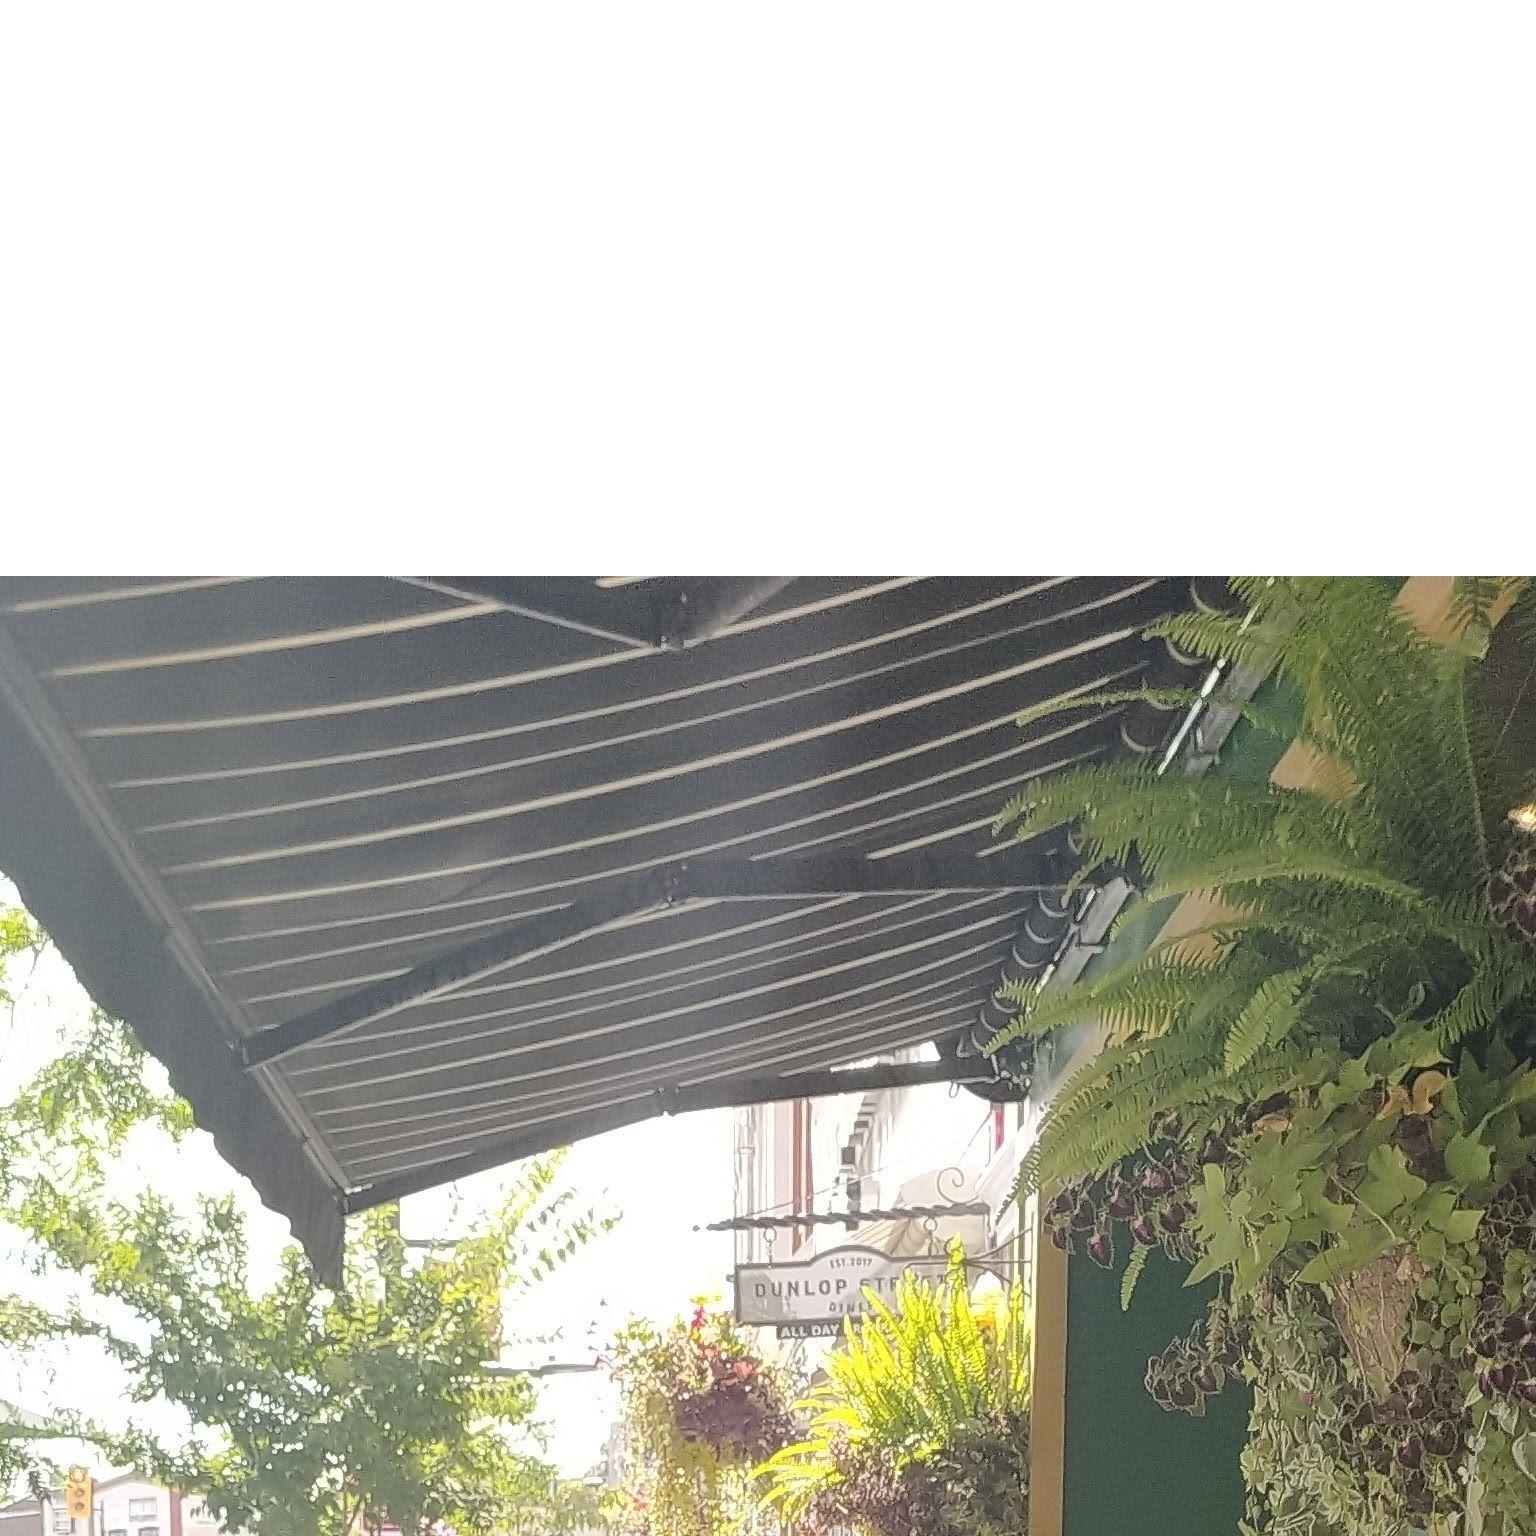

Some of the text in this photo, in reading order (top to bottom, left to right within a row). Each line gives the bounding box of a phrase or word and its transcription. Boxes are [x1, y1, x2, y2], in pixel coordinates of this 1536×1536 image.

[754, 1278, 848, 1297] DUNLOP
[780, 1325, 807, 1338] ALL
[812, 1323, 840, 1337] DAY
